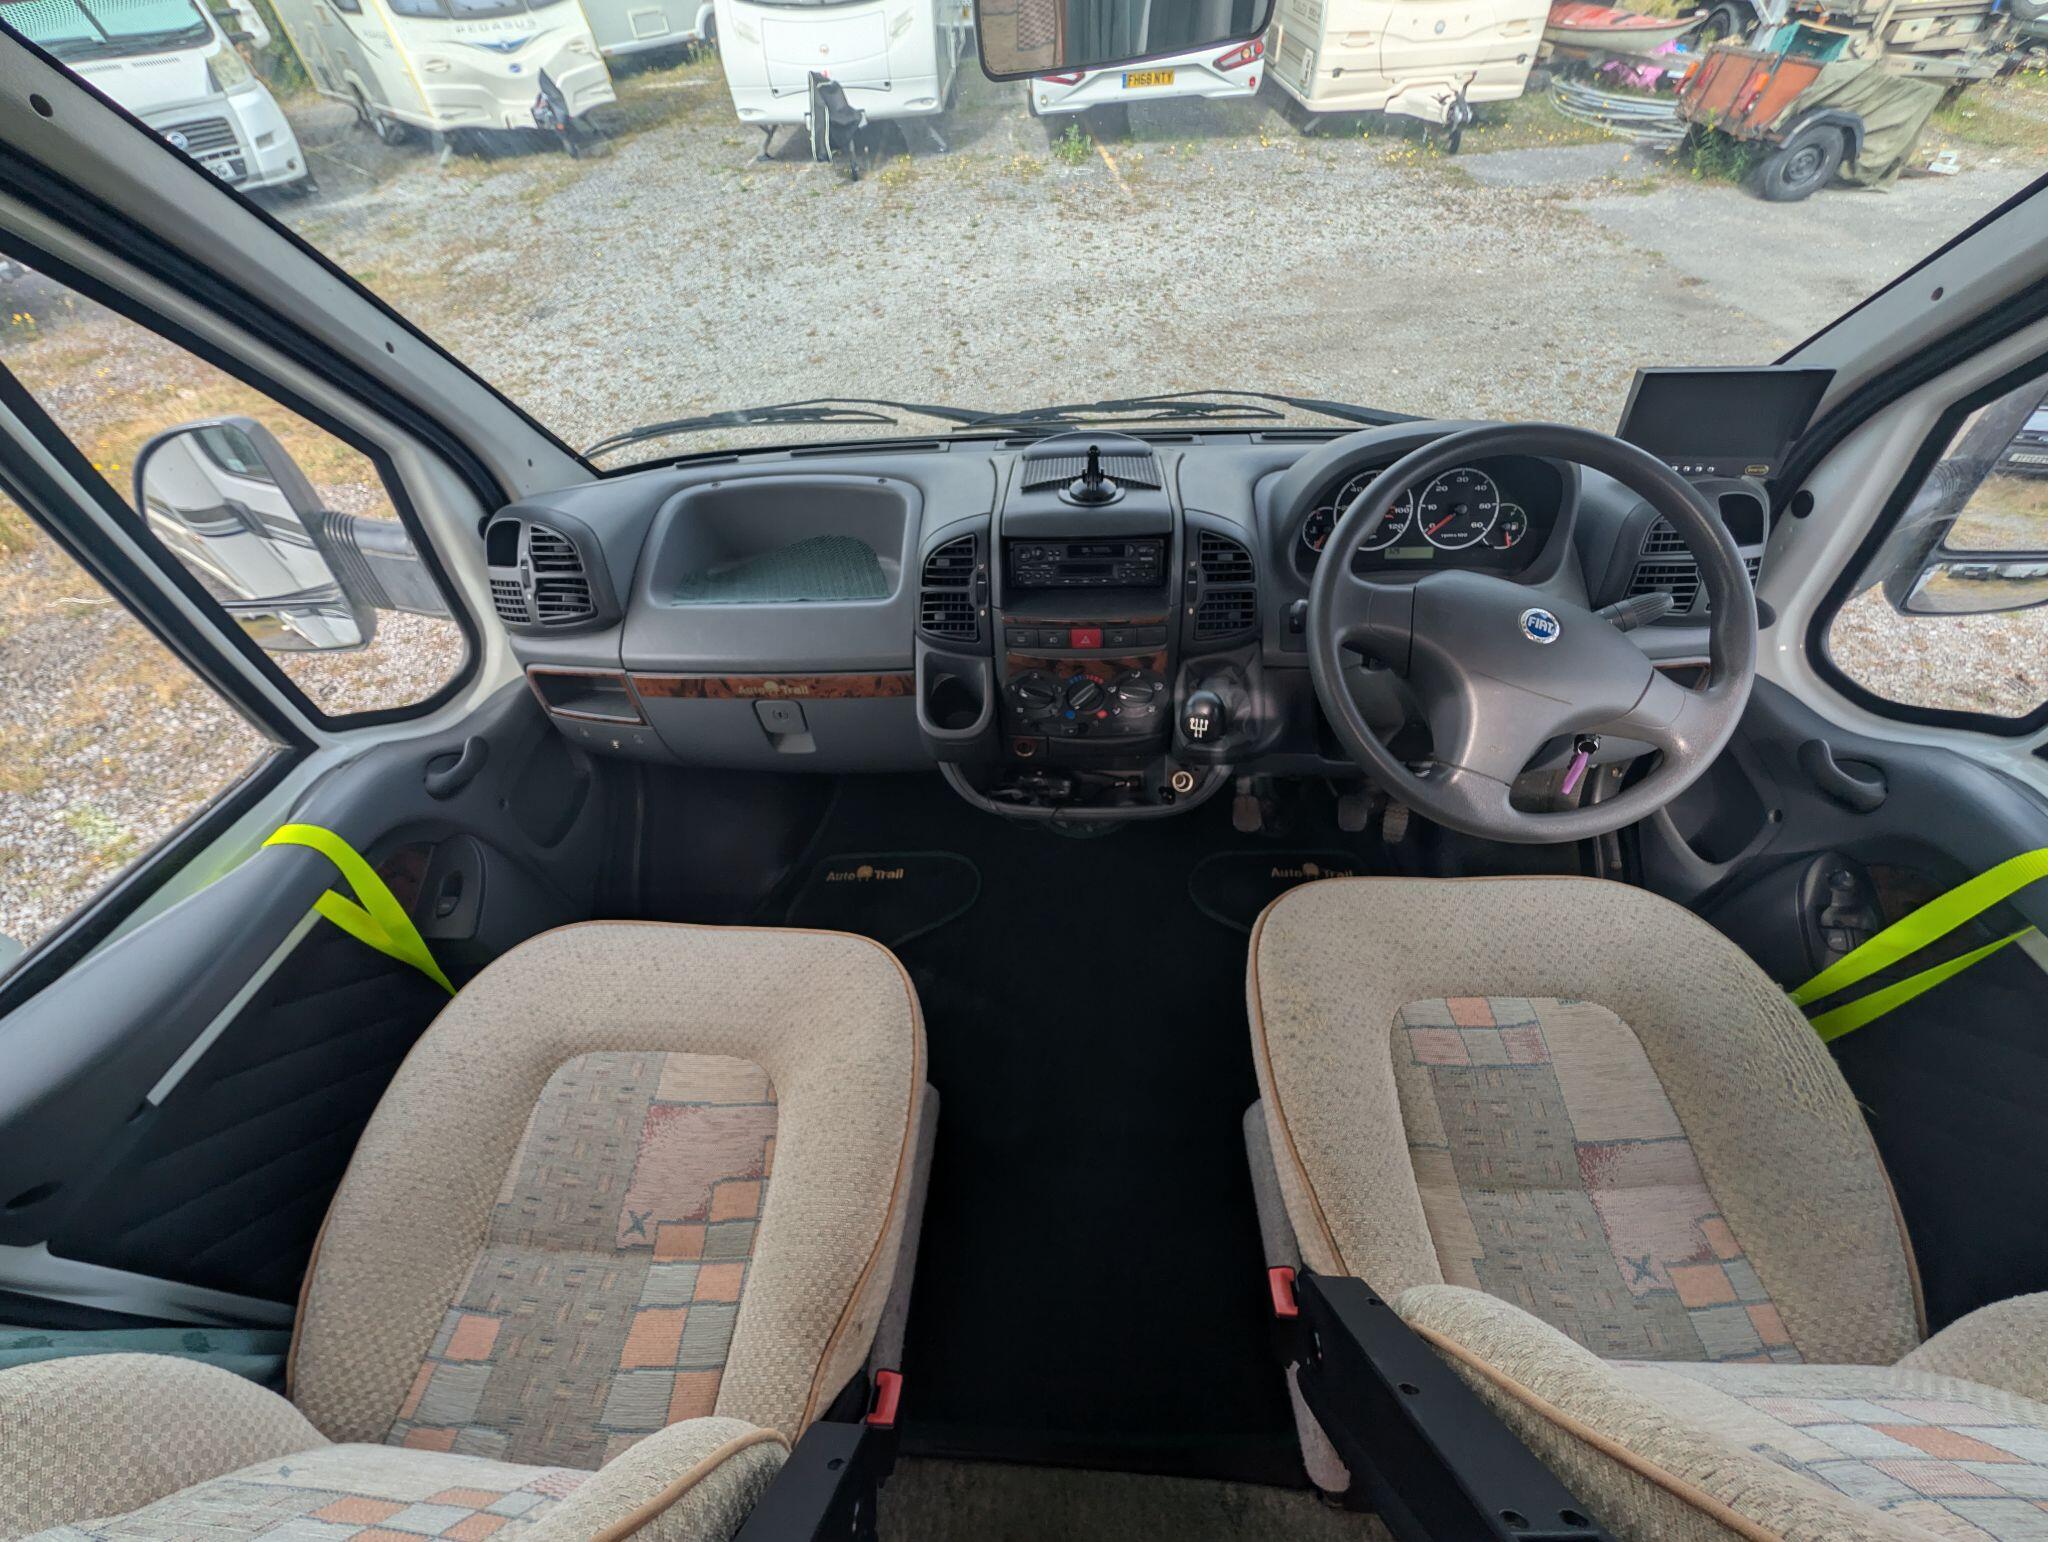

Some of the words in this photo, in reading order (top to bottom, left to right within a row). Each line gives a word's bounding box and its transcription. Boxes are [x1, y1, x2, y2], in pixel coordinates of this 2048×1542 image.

[1427, 503, 1438, 511] 10
[1470, 521, 1484, 529] 60
[1527, 616, 1555, 634] FIAT
[826, 871, 856, 882] Auto
[874, 868, 904, 881] Trail
[1271, 867, 1302, 878] Auto
